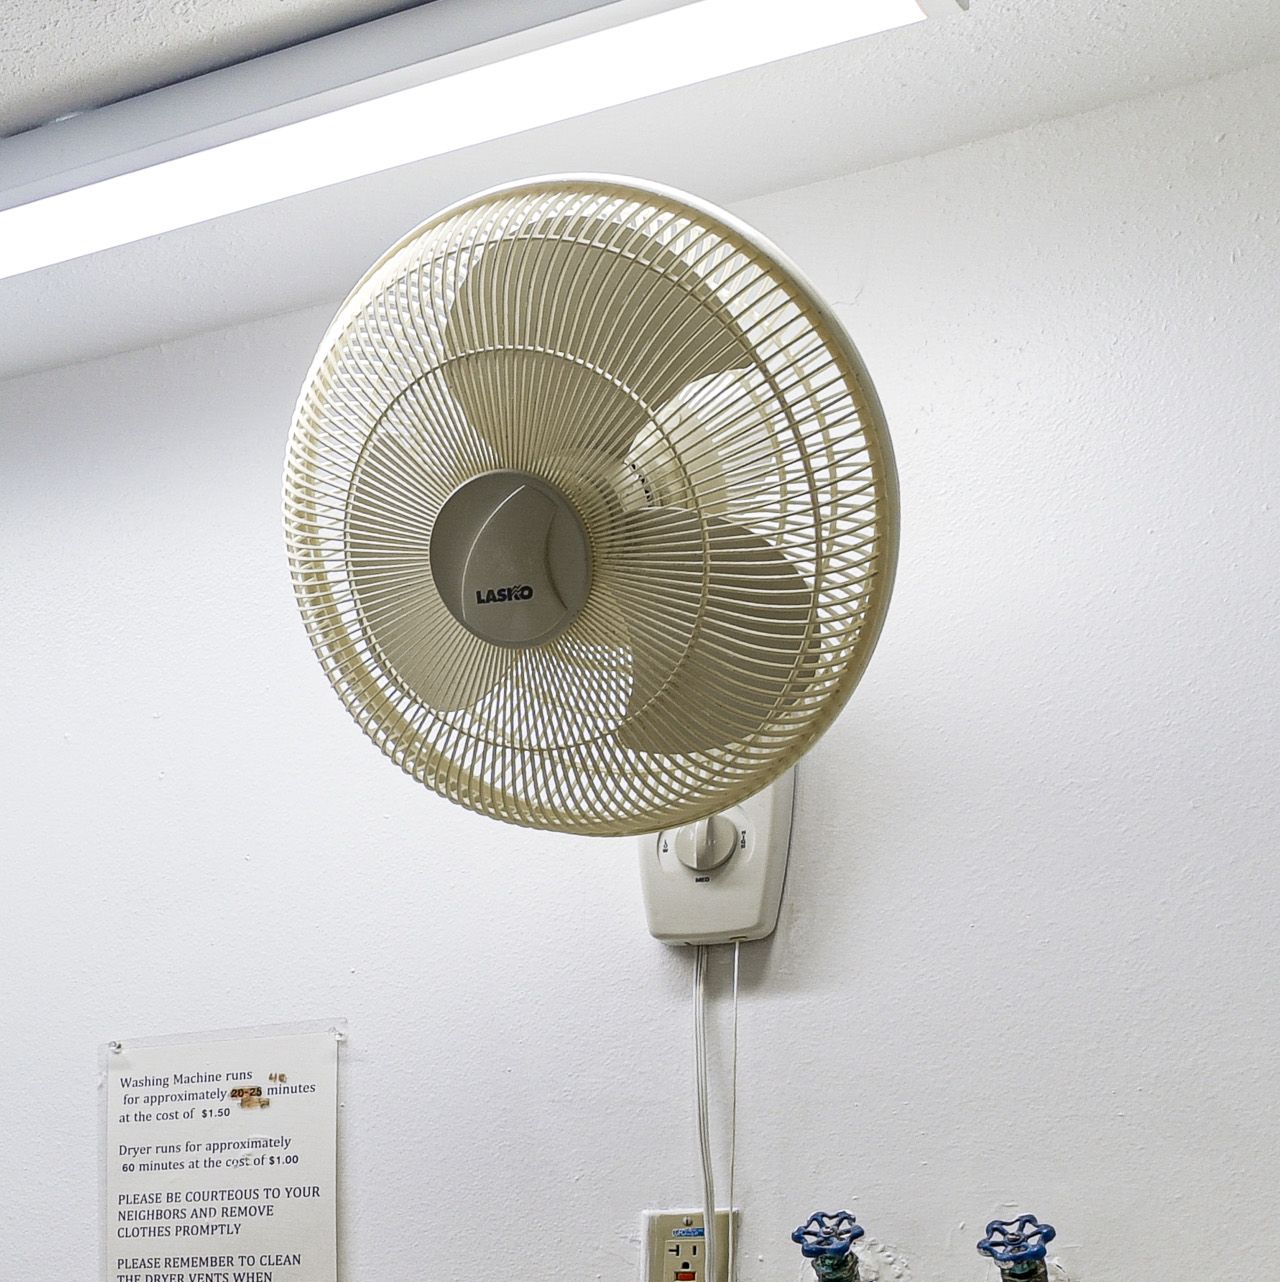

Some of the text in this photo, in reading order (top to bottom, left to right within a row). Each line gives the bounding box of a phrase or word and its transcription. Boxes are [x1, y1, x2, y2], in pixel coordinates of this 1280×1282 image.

[476, 585, 533, 604] LASKO
[120, 1071, 253, 1089] Washing Machine runs
[123, 1094, 140, 1105] for
[143, 1089, 227, 1106] approximately
[267, 1082, 316, 1096] minutes
[119, 1107, 230, 1123] at the cost of $1.50
[119, 1136, 292, 1156] Dryer runs for approximately
[122, 1154, 298, 1172] 60 minutes at the cost of $1.00
[118, 1186, 320, 1205] PLEASE BE COURTEOUS TO YOUR
[118, 1205, 274, 1221] NEIGHBORS AND REMOVE
[117, 1223, 241, 1238] CLOTHES PROMPTLY
[117, 1254, 301, 1269] PLEASE REMEMBER TO CLEAN
[232, 1271, 273, 1282] WHEN
